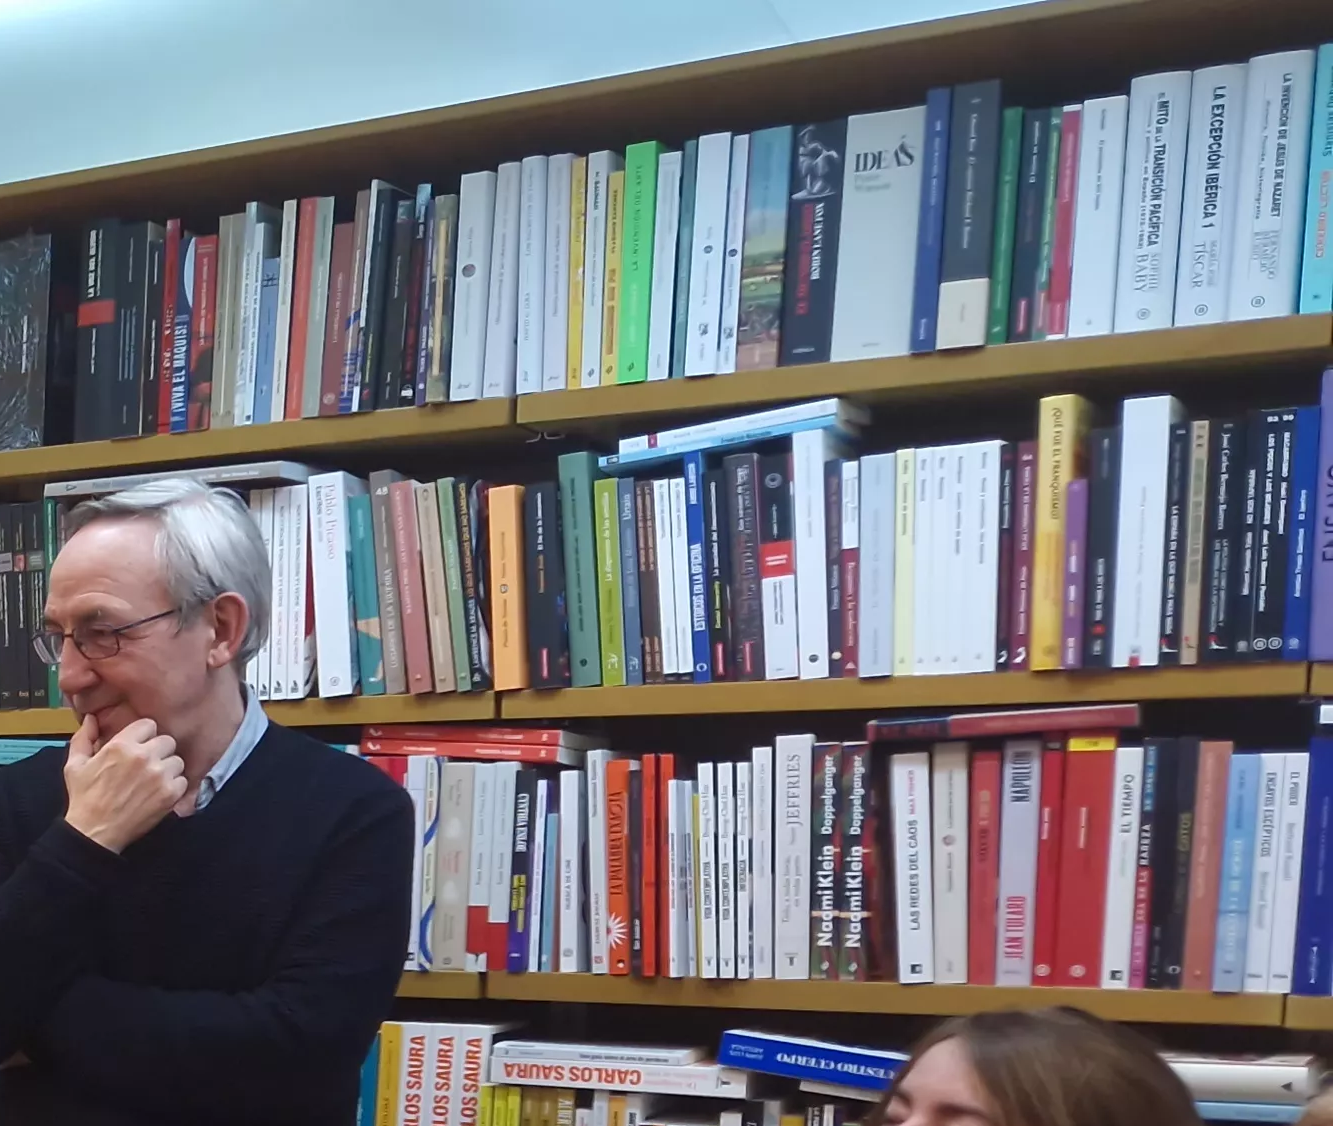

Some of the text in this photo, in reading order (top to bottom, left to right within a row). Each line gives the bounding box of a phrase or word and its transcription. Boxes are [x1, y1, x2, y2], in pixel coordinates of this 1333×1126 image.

[1213, 85, 1227, 101] LA
[1206, 104, 1226, 170] EXCEPCIÓN
[1147, 100, 1170, 247] MITO TRANSICIÓN PACÍFICA
[1202, 173, 1222, 219] IBÉRICA
[1133, 253, 1149, 292] BABY
[173, 325, 188, 367] MAQUIS!
[172, 369, 186, 382] EL
[786, 754, 803, 826] JEFFRIES
[1290, 771, 1301, 780] EL
[1121, 774, 1135, 834] EL TIEMPO
[816, 755, 837, 947] Naomi Klein Doppelganger
[844, 755, 865, 948] Naomi Klein Doppelganger
[1259, 809, 1278, 857] ESCÉPTICOS
[908, 819, 921, 931] LAS REDES DEL CAOS
[1003, 895, 1026, 960] JEAN TULARD
[405, 1035, 426, 1090] SAURA
[434, 1036, 455, 1092] SAURA
[462, 1038, 483, 1093] SAURA
[504, 1063, 642, 1086] CARLOS SAURA
[776, 1052, 835, 1070] CUERPO
